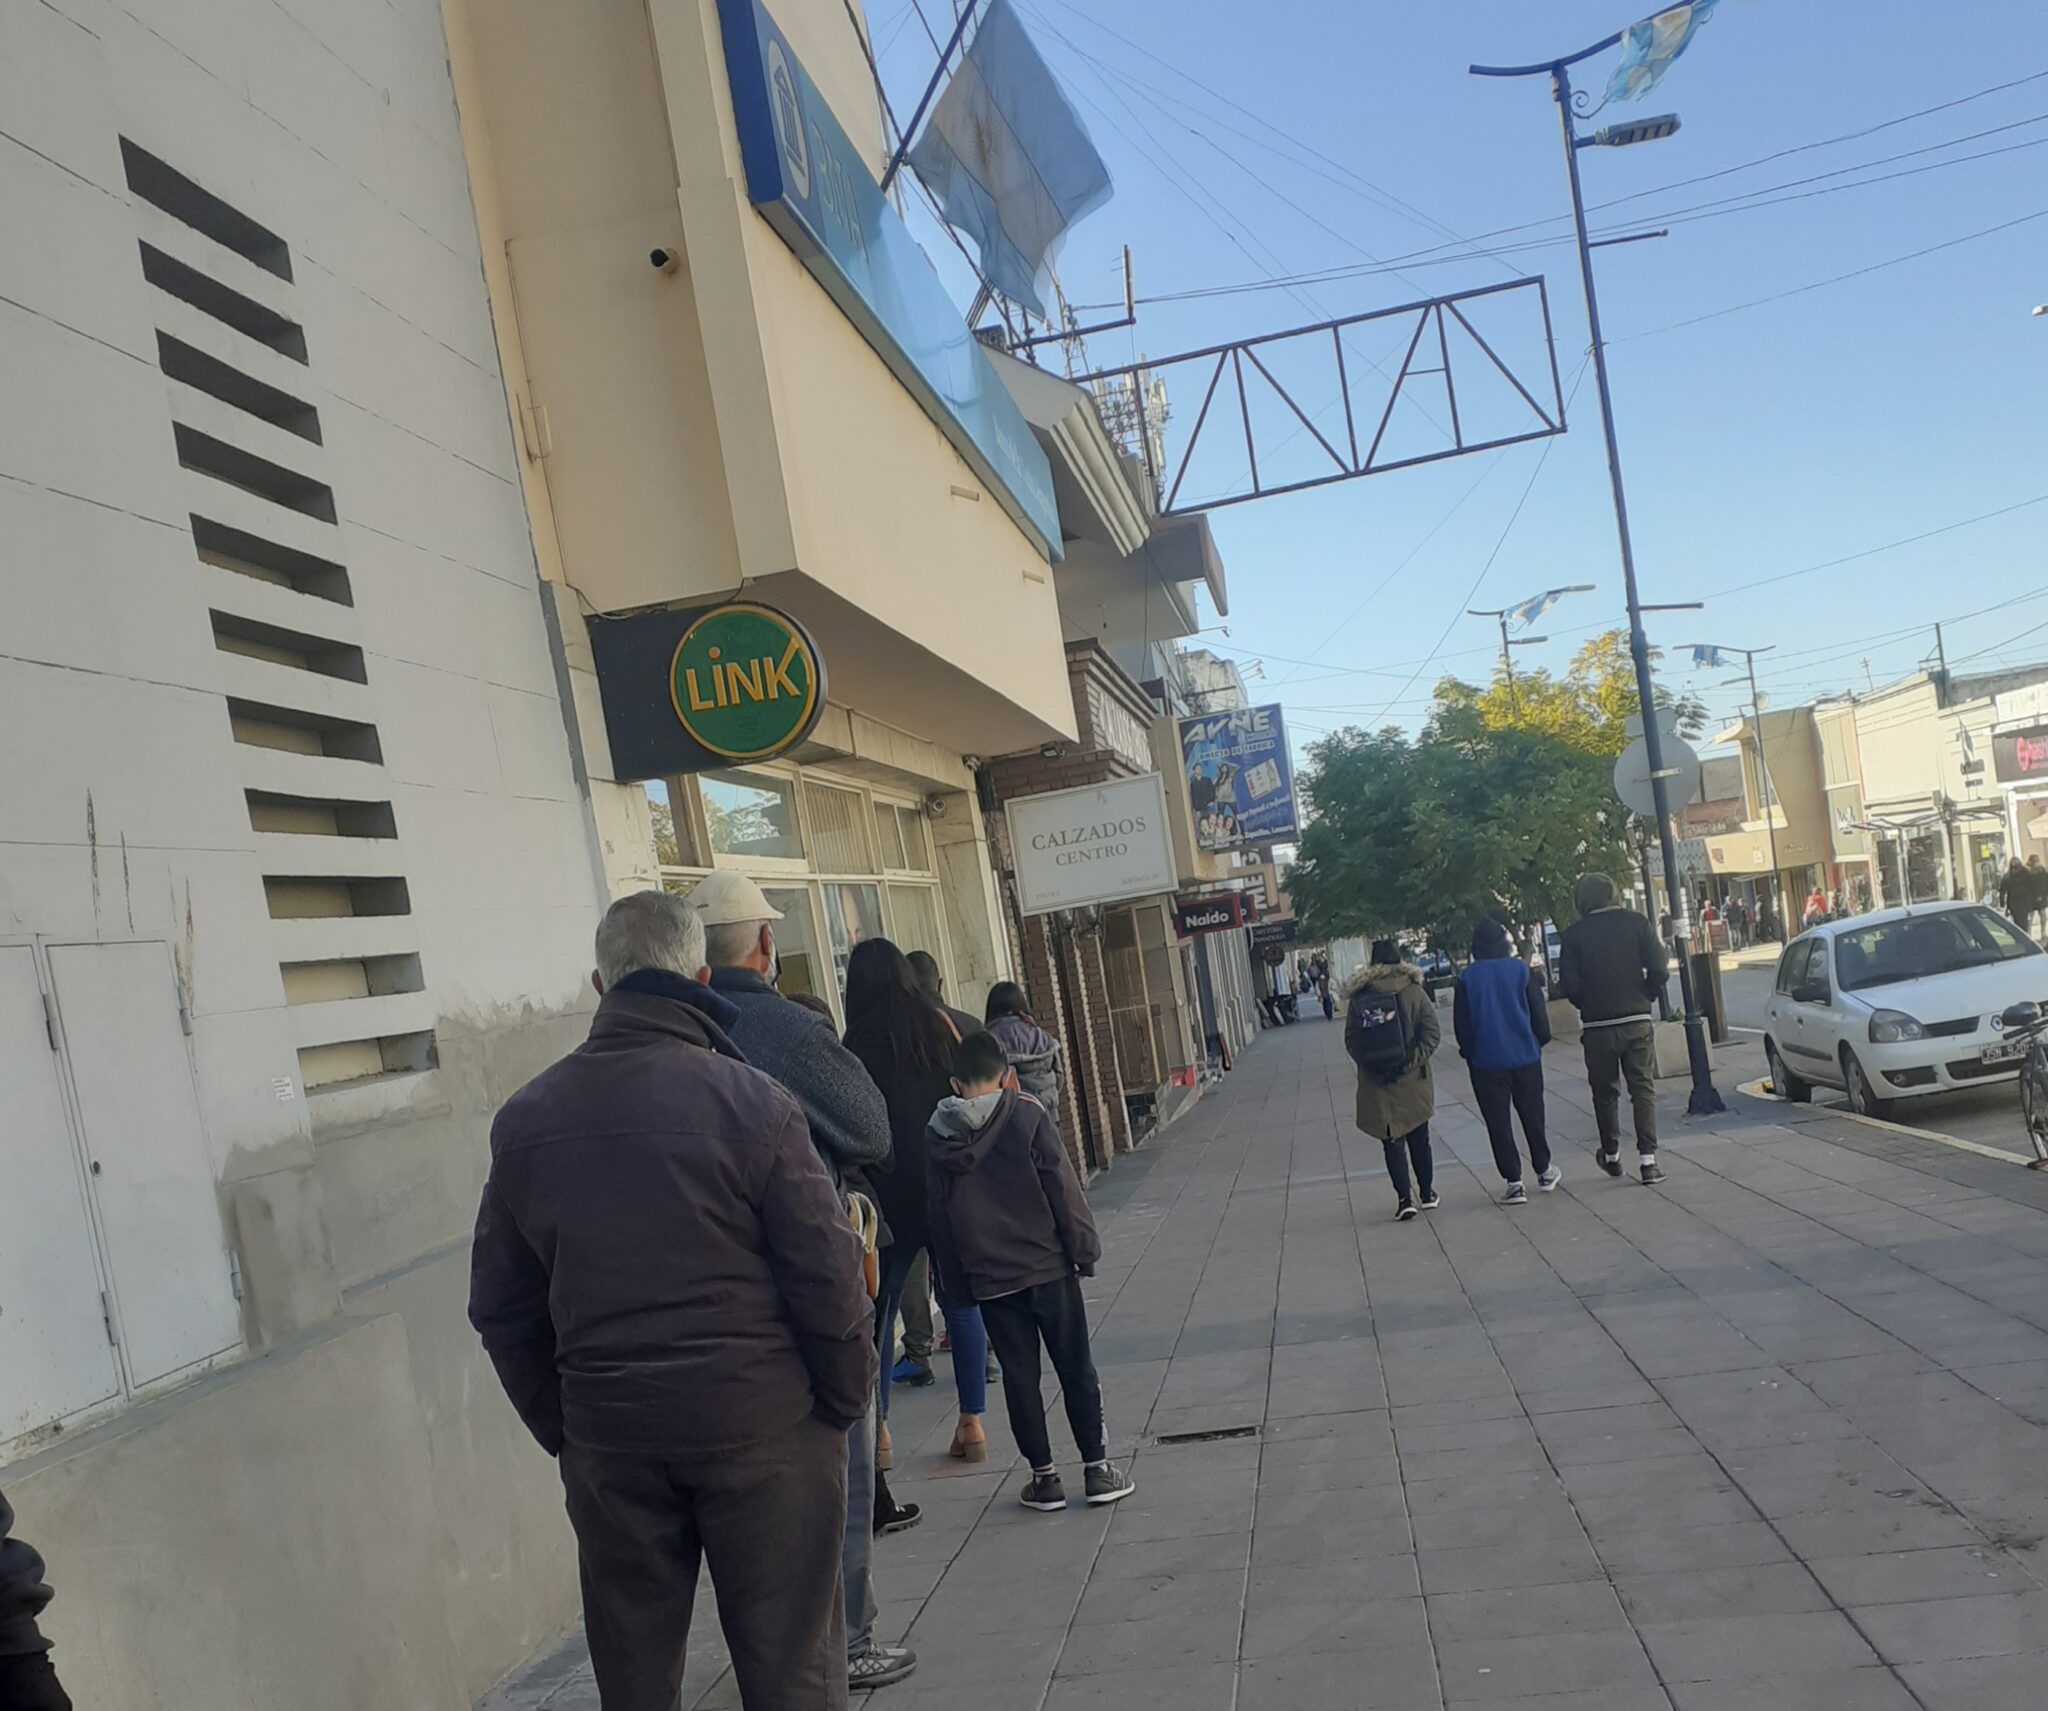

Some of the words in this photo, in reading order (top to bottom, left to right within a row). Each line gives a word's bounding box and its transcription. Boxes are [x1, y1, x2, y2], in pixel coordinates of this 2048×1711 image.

[1031, 816, 1147, 851] CALZADOS
[1055, 843, 1128, 867] CENTRO
[1184, 911, 1229, 928] Naldo
